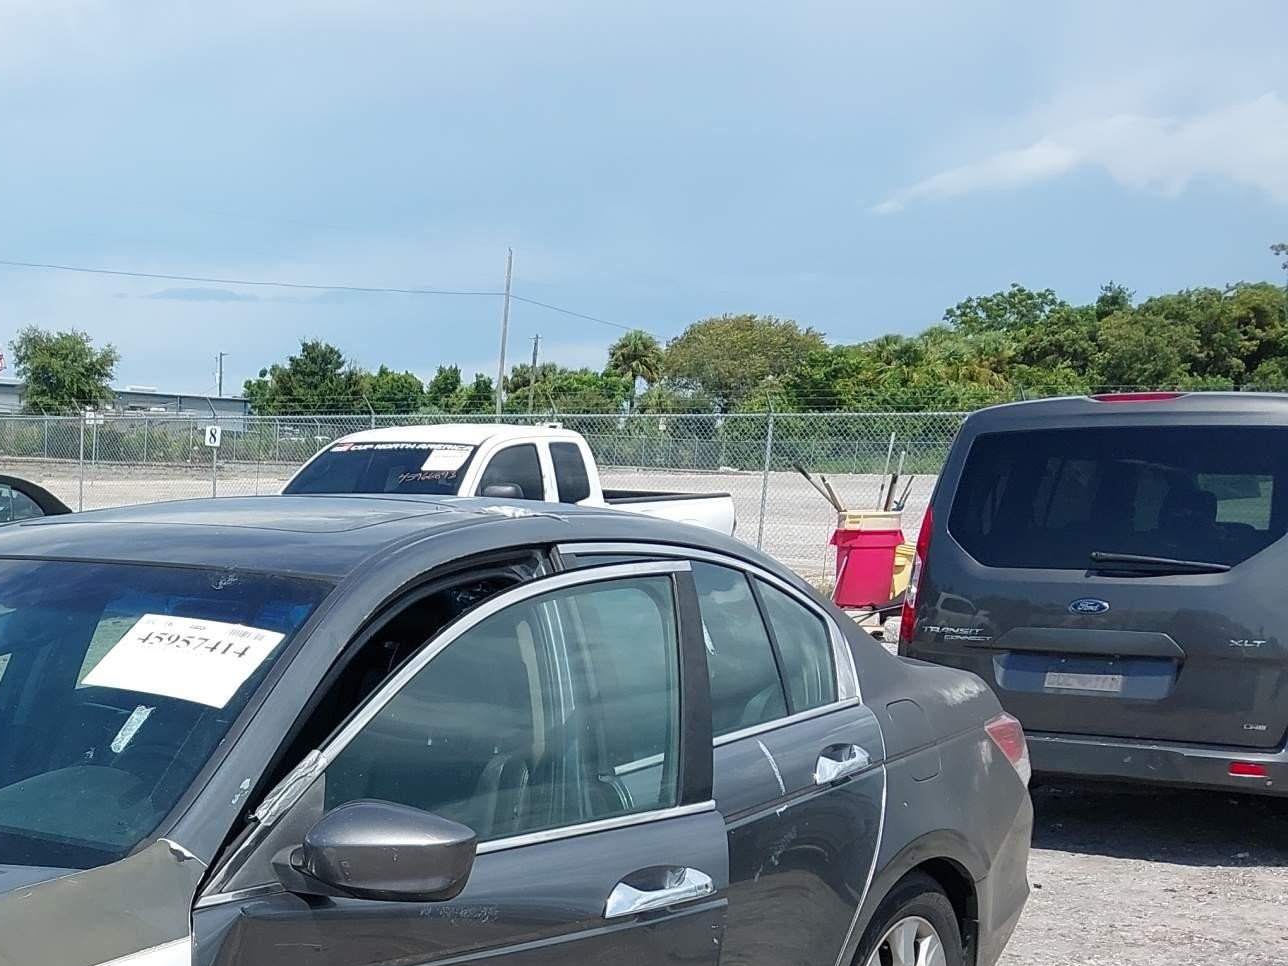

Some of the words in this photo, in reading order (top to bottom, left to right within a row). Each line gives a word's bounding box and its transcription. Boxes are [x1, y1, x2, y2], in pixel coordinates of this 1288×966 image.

[209, 427, 217, 444] 8
[922, 626, 984, 635] TRANSIT
[138, 631, 251, 658] 45957414
[1229, 639, 1267, 647] XLT
